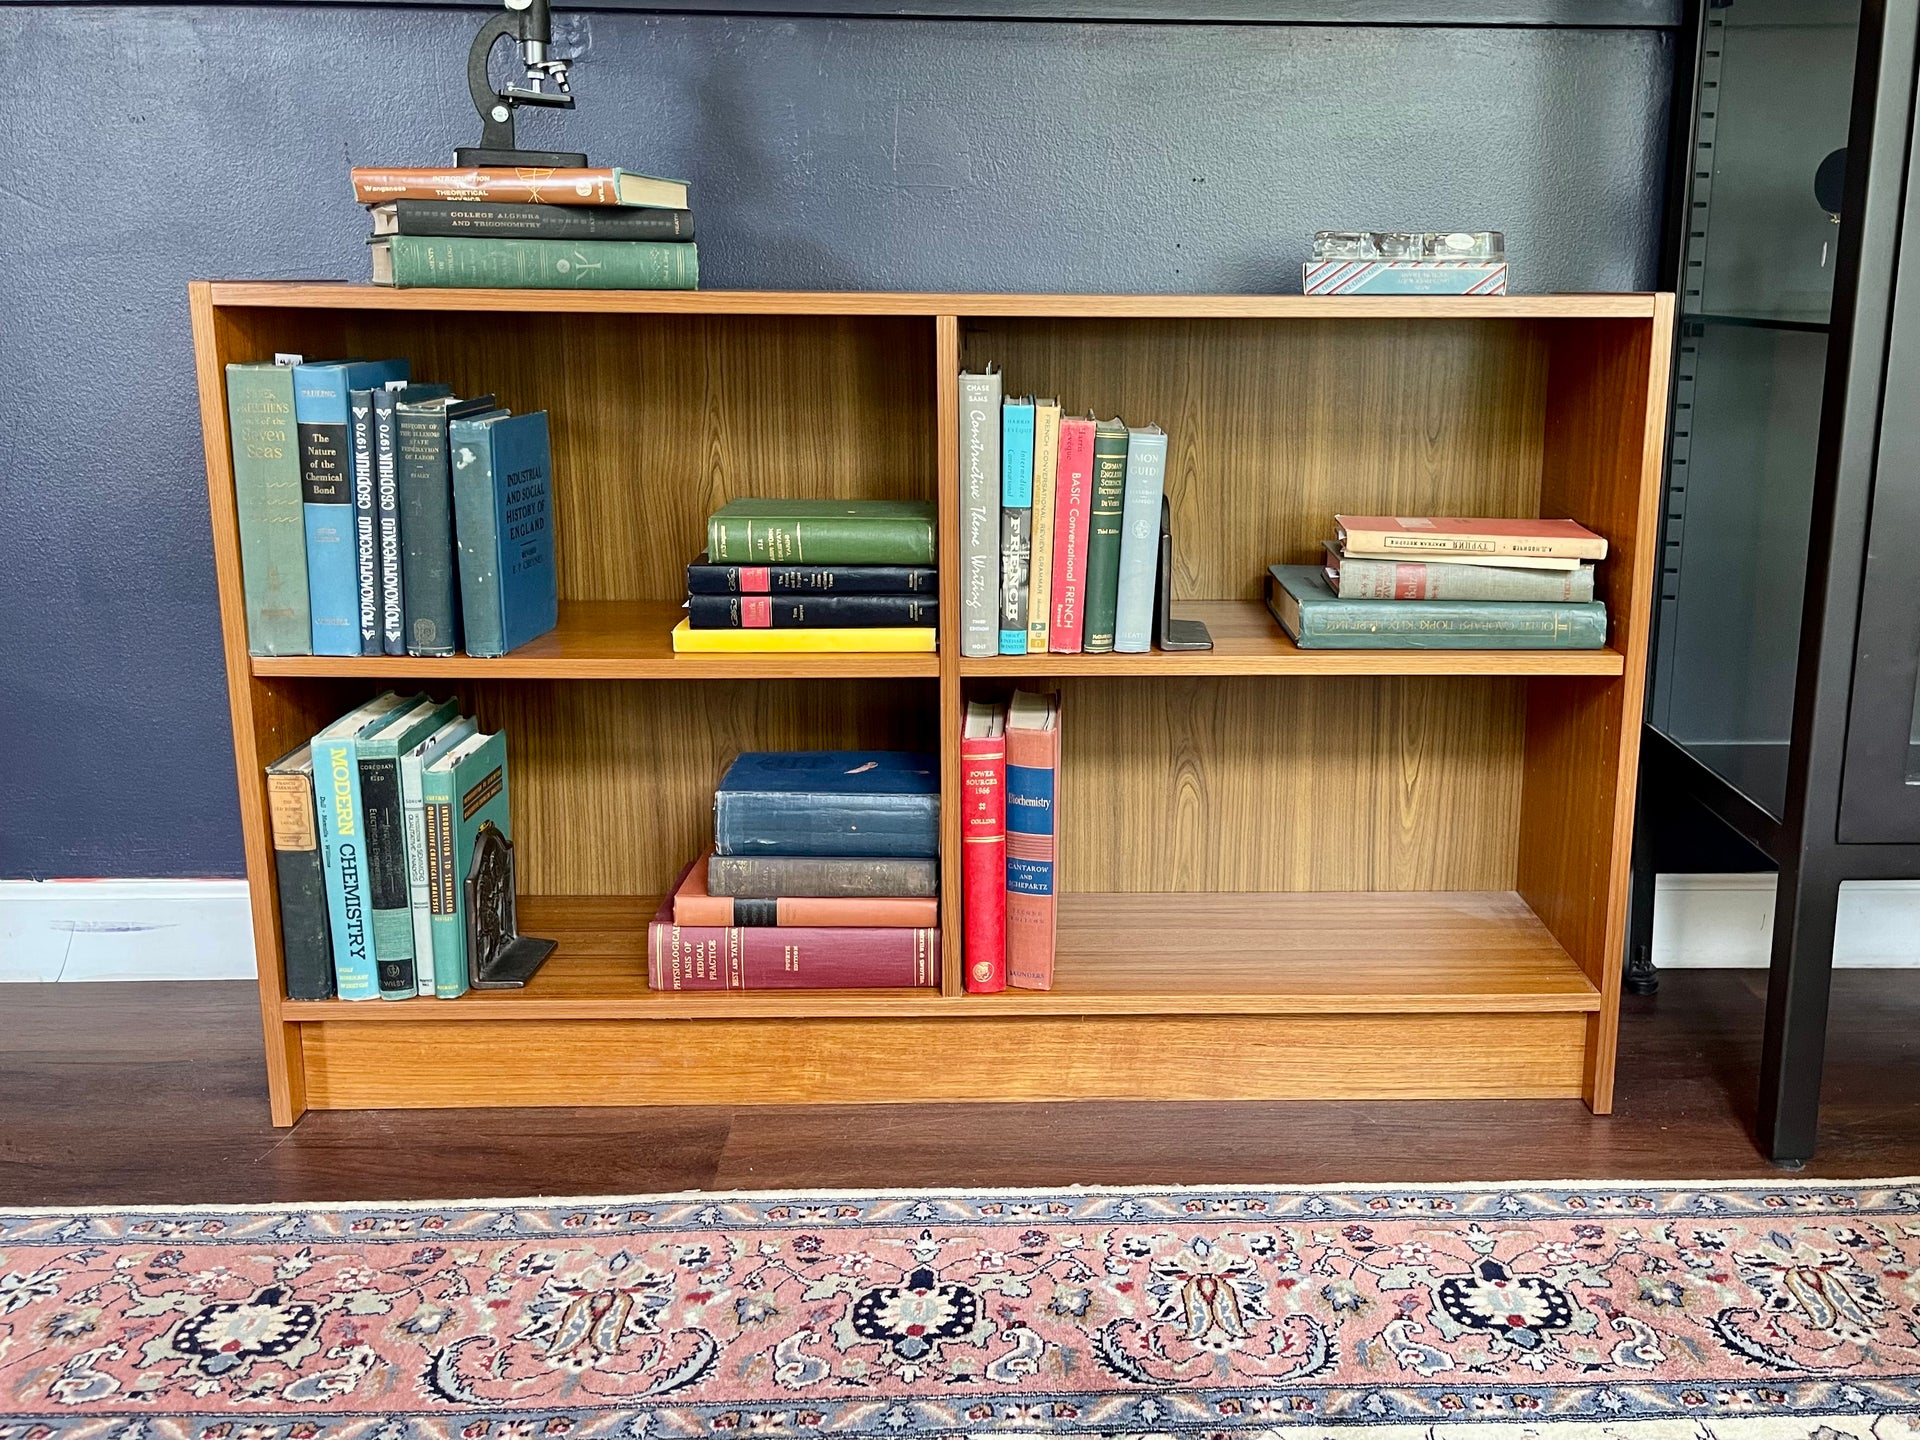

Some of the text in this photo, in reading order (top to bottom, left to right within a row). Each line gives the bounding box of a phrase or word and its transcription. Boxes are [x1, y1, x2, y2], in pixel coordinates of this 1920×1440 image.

[450, 211, 540, 221] COLLEGE ALGEBRA
[451, 219, 542, 229] AND TRIGONOMETRY
[966, 384, 990, 392] CHASE
[968, 395, 988, 403] SAMS
[311, 433, 330, 443] The
[356, 422, 368, 450] 1970
[379, 424, 390, 451] 1970
[400, 422, 426, 430] HISTORY
[1042, 413, 1051, 447] FRENCH
[247, 443, 283, 459] Seas
[307, 446, 337, 456] Nature
[1134, 453, 1159, 464] MON
[310, 459, 335, 469] of the
[1019, 450, 1028, 498] Intermediate
[1100, 470, 1123, 478] ENGLISH
[305, 471, 343, 483] Chemical
[507, 466, 543, 488] INDUSTRIAL
[1039, 450, 1049, 521] CONVERSATIONAL
[1070, 471, 1083, 505] BASIC
[1100, 478, 1122, 486] SCIENCE
[312, 484, 336, 495] Bond
[506, 482, 545, 506] AND SOCIAL
[506, 499, 546, 524] HISTORY OF
[965, 409, 988, 609] Constructive Theme Writing
[510, 517, 545, 541] ENGLAND
[1038, 523, 1047, 553] REVIEW
[1065, 508, 1080, 582] Conversational
[1452, 541, 1488, 550] ТУРЦИЯ
[1005, 517, 1021, 622] FRENCH
[1036, 555, 1045, 595] GRAMMAR
[1056, 603, 1064, 628] Revised
[1062, 585, 1075, 629] FRENCH
[965, 778, 998, 786] SOURCES
[975, 787, 991, 795] 1966
[1008, 791, 1052, 811] Biochemistry
[369, 808, 380, 847] ELECTRICAL
[330, 747, 367, 960] MODERN CHEMISTRY
[408, 814, 419, 882] QUALITATIVE ANALYSIS
[427, 806, 440, 913] QUALITATIVE CHEMICAL ANALYSIS
[441, 805, 454, 913] INTRODUCTION TO SEMIMICRO
[417, 848, 426, 882] SEMIMICRO
[1007, 862, 1049, 873] CANTAROW
[730, 927, 739, 957] TAYLOR
[683, 941, 693, 979] BASIS OF
[696, 941, 705, 979] MEDICAL
[708, 939, 718, 981] PRACTICE
[731, 970, 740, 987] BEST
[1009, 970, 1045, 979] SAUNDERS
